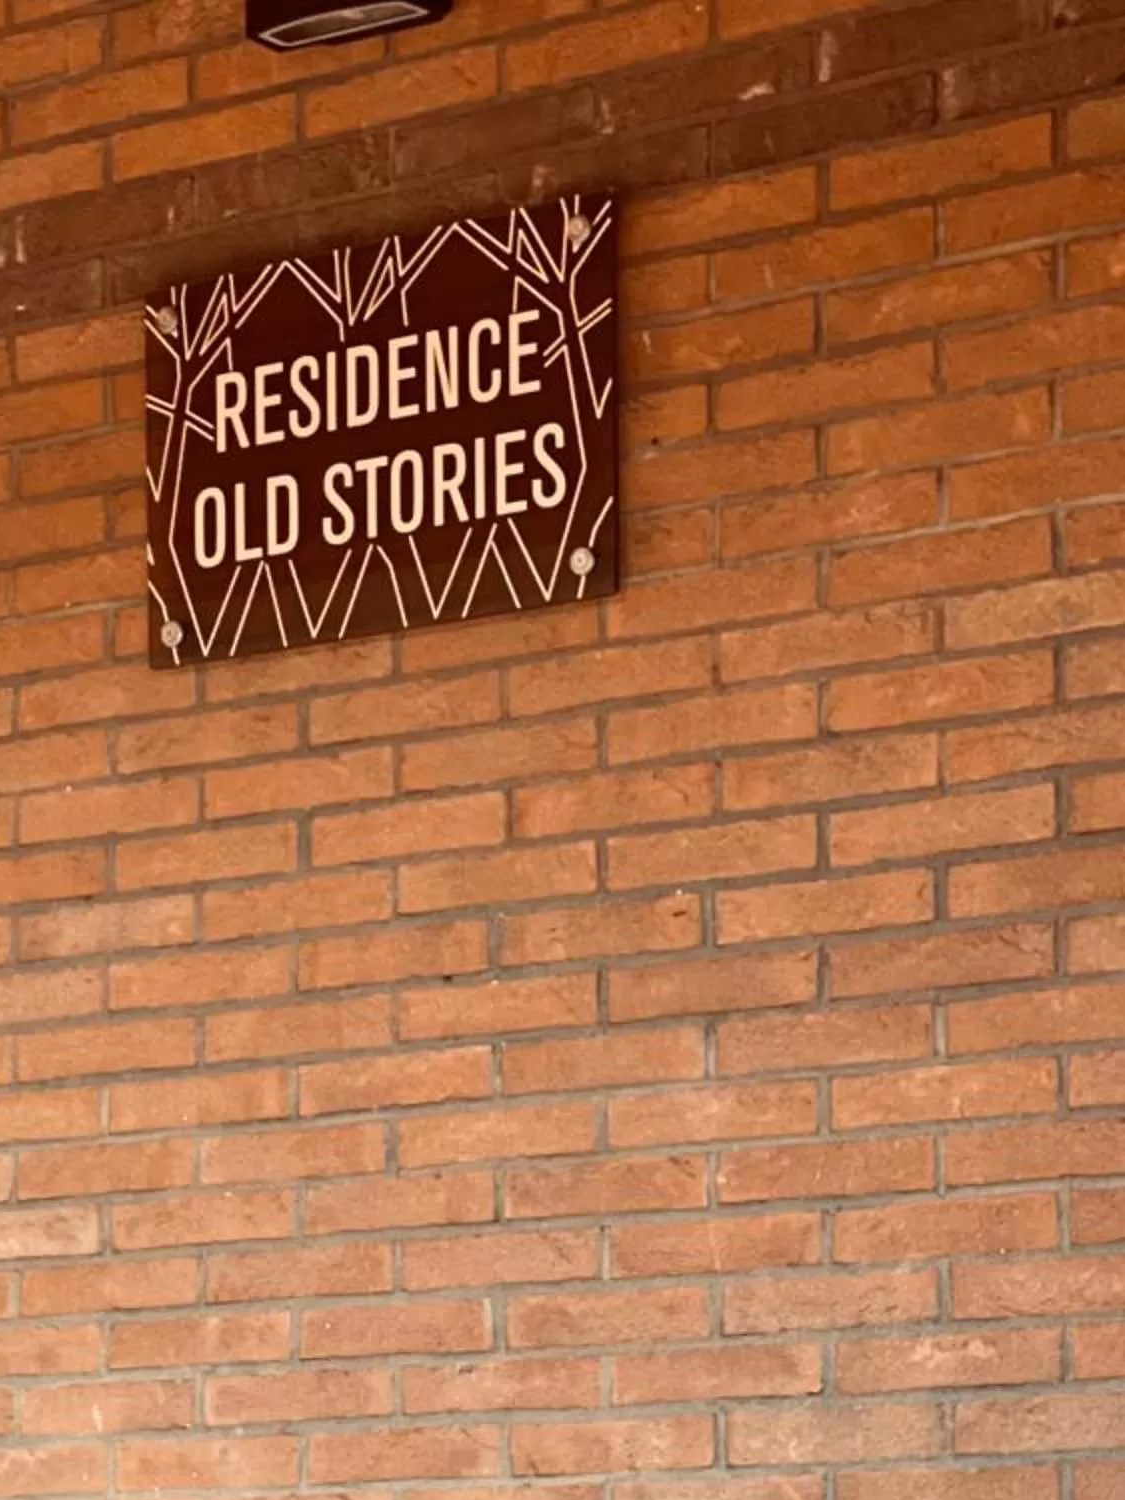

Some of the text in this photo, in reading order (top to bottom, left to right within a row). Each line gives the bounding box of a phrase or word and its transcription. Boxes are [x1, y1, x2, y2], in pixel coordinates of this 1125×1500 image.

[216, 309, 541, 453] RESIDENCE
[194, 422, 567, 569] OLD STORIES
